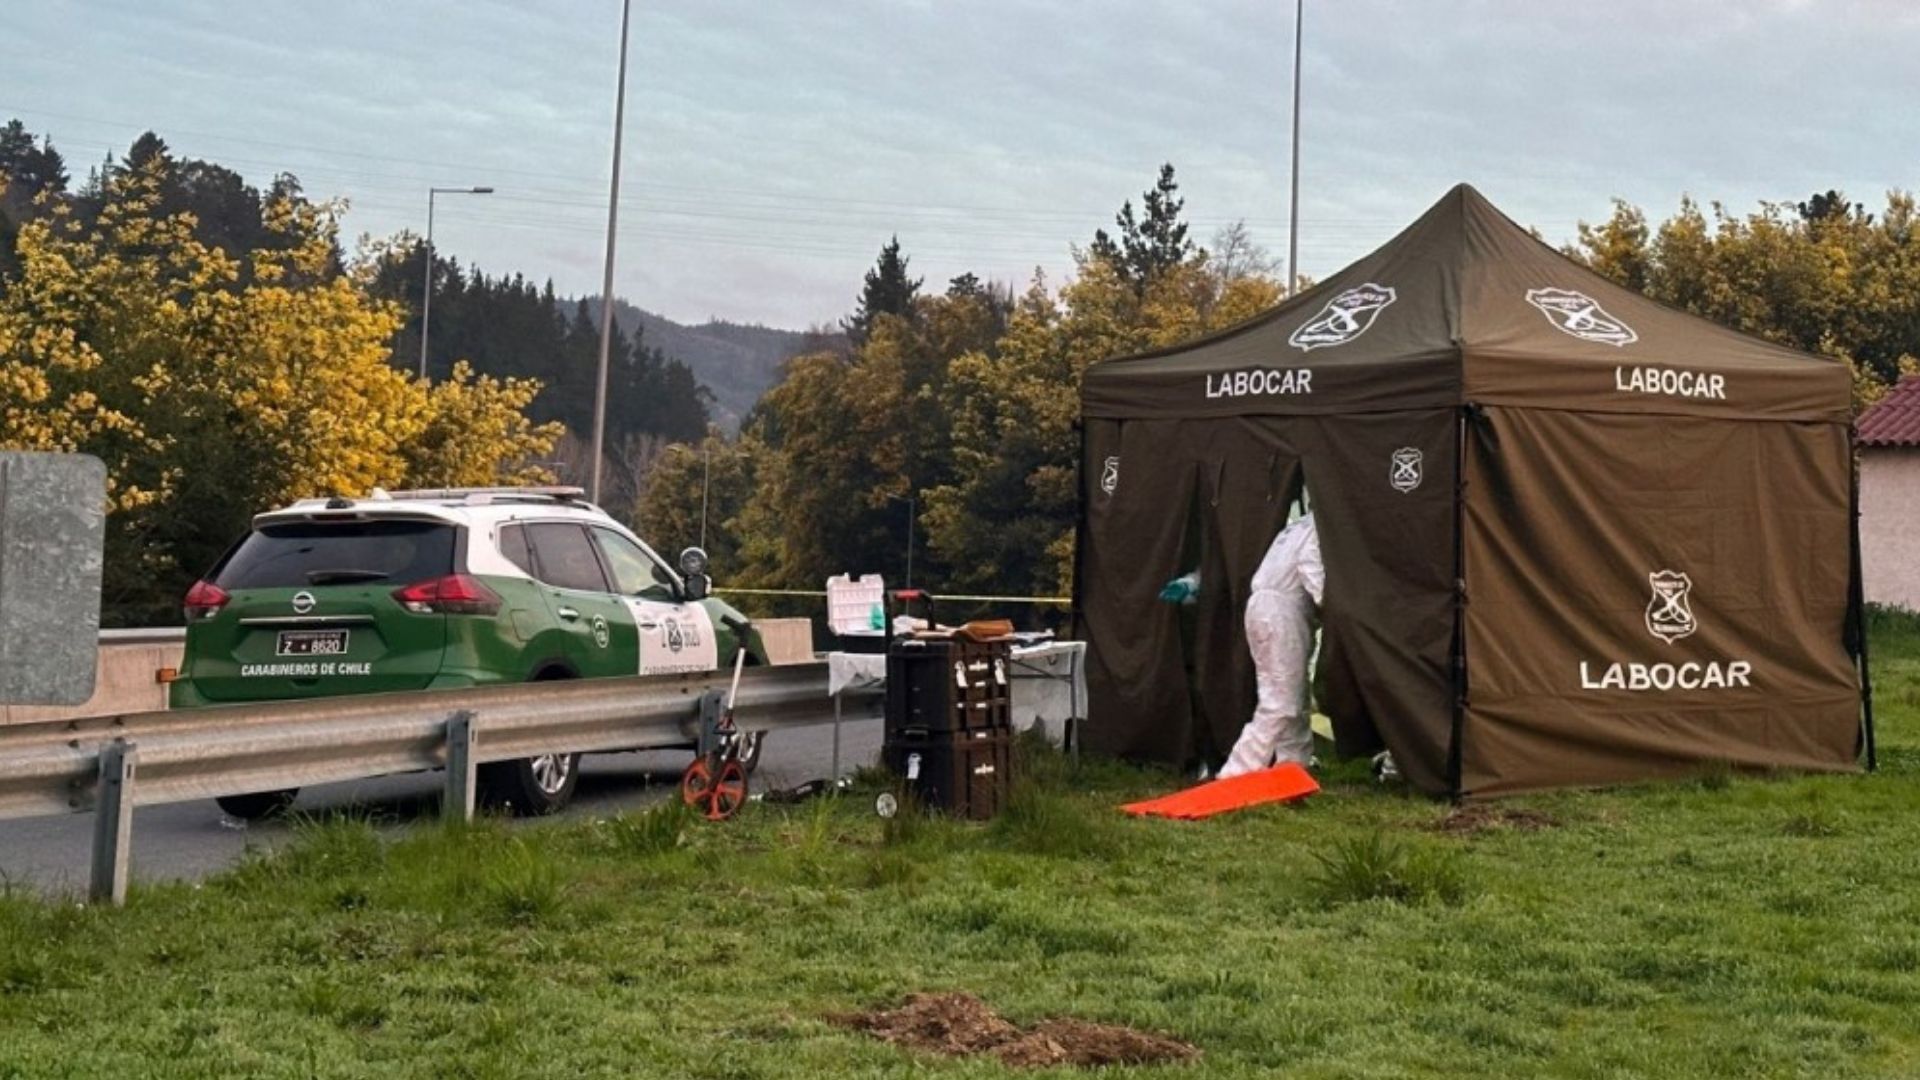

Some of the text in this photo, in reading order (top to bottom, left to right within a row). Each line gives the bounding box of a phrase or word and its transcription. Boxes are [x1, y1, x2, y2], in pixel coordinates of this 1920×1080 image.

[1205, 369, 1312, 398] LABOCAR
[1615, 366, 1726, 400] LABOCAR
[283, 641, 293, 653] Z
[241, 662, 372, 677] CARABINEROS DE CHILE
[1579, 660, 1751, 691] LABOCAR
